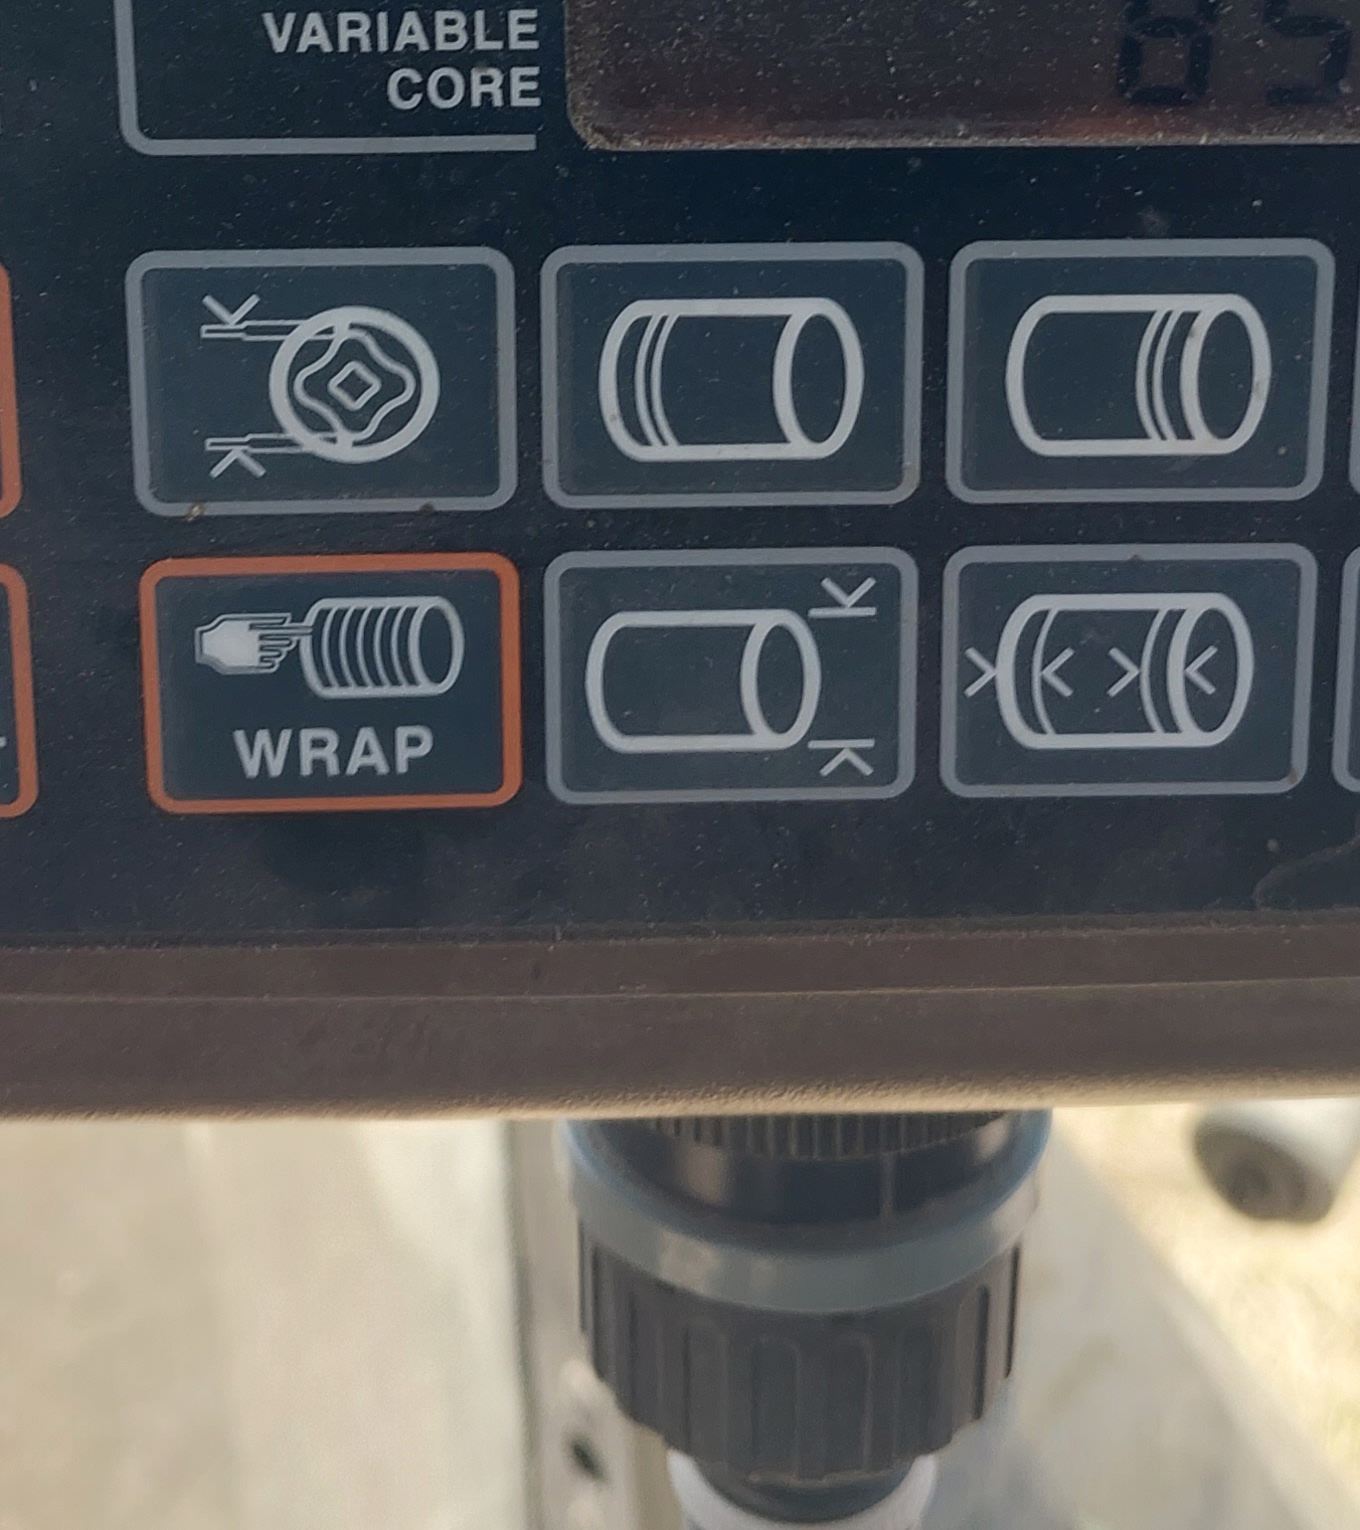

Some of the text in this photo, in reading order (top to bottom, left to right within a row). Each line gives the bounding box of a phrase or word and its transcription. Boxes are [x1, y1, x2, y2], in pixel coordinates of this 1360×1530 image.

[261, 8, 541, 54] VARIABLE
[386, 65, 542, 111] CORE
[232, 724, 434, 779] WRAP
